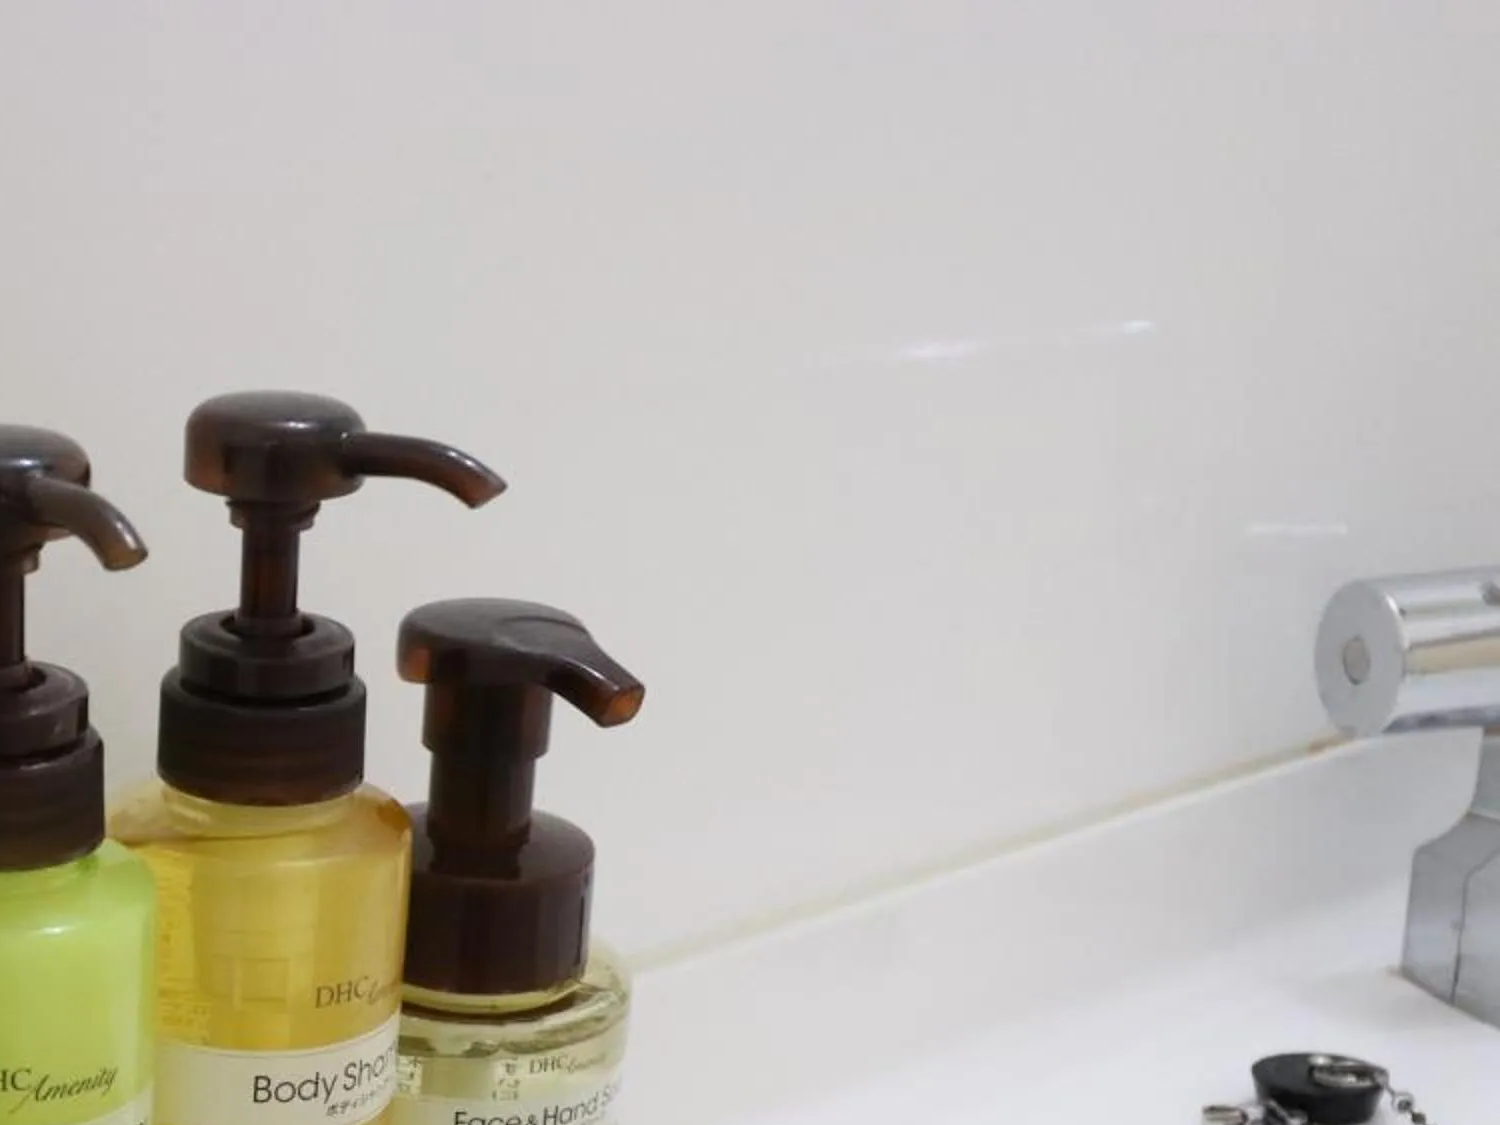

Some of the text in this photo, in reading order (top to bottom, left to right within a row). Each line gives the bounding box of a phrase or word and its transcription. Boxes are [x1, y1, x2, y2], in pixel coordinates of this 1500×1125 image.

[315, 975, 369, 1009] DHC
[529, 1053, 569, 1075] DHC
[7, 1066, 119, 1115] Amenity
[252, 1071, 338, 1105] Body
